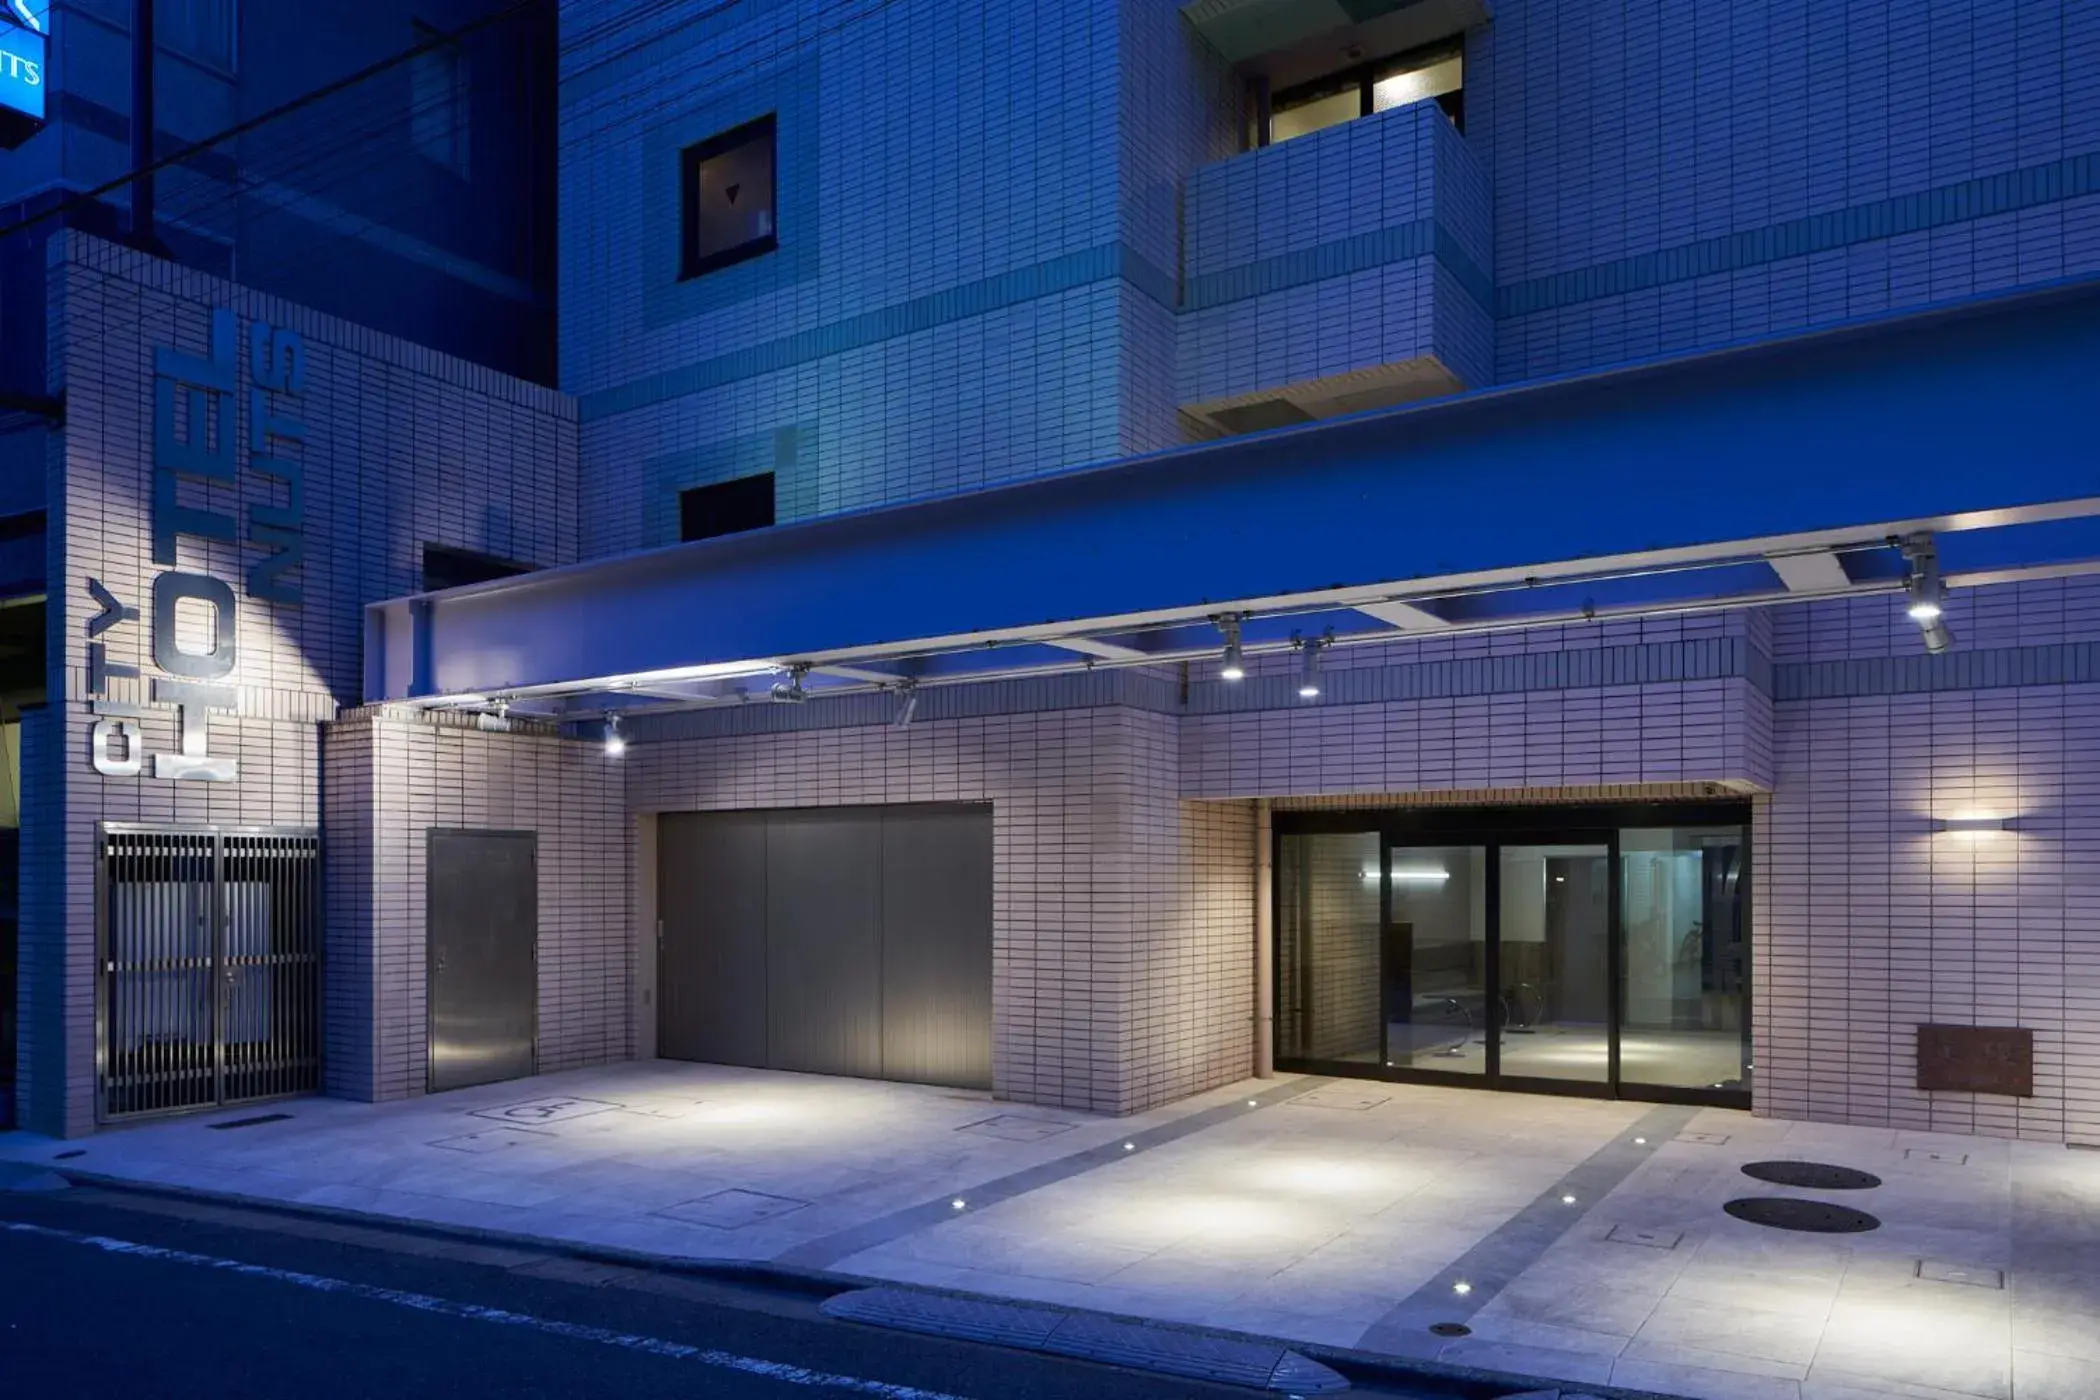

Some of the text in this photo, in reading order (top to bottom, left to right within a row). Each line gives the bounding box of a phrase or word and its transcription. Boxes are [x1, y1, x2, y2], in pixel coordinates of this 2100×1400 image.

[0, 49, 40, 85] TS
[153, 307, 236, 781] HOTEL
[247, 321, 304, 599] NUTS
[91, 577, 141, 776] CITY
